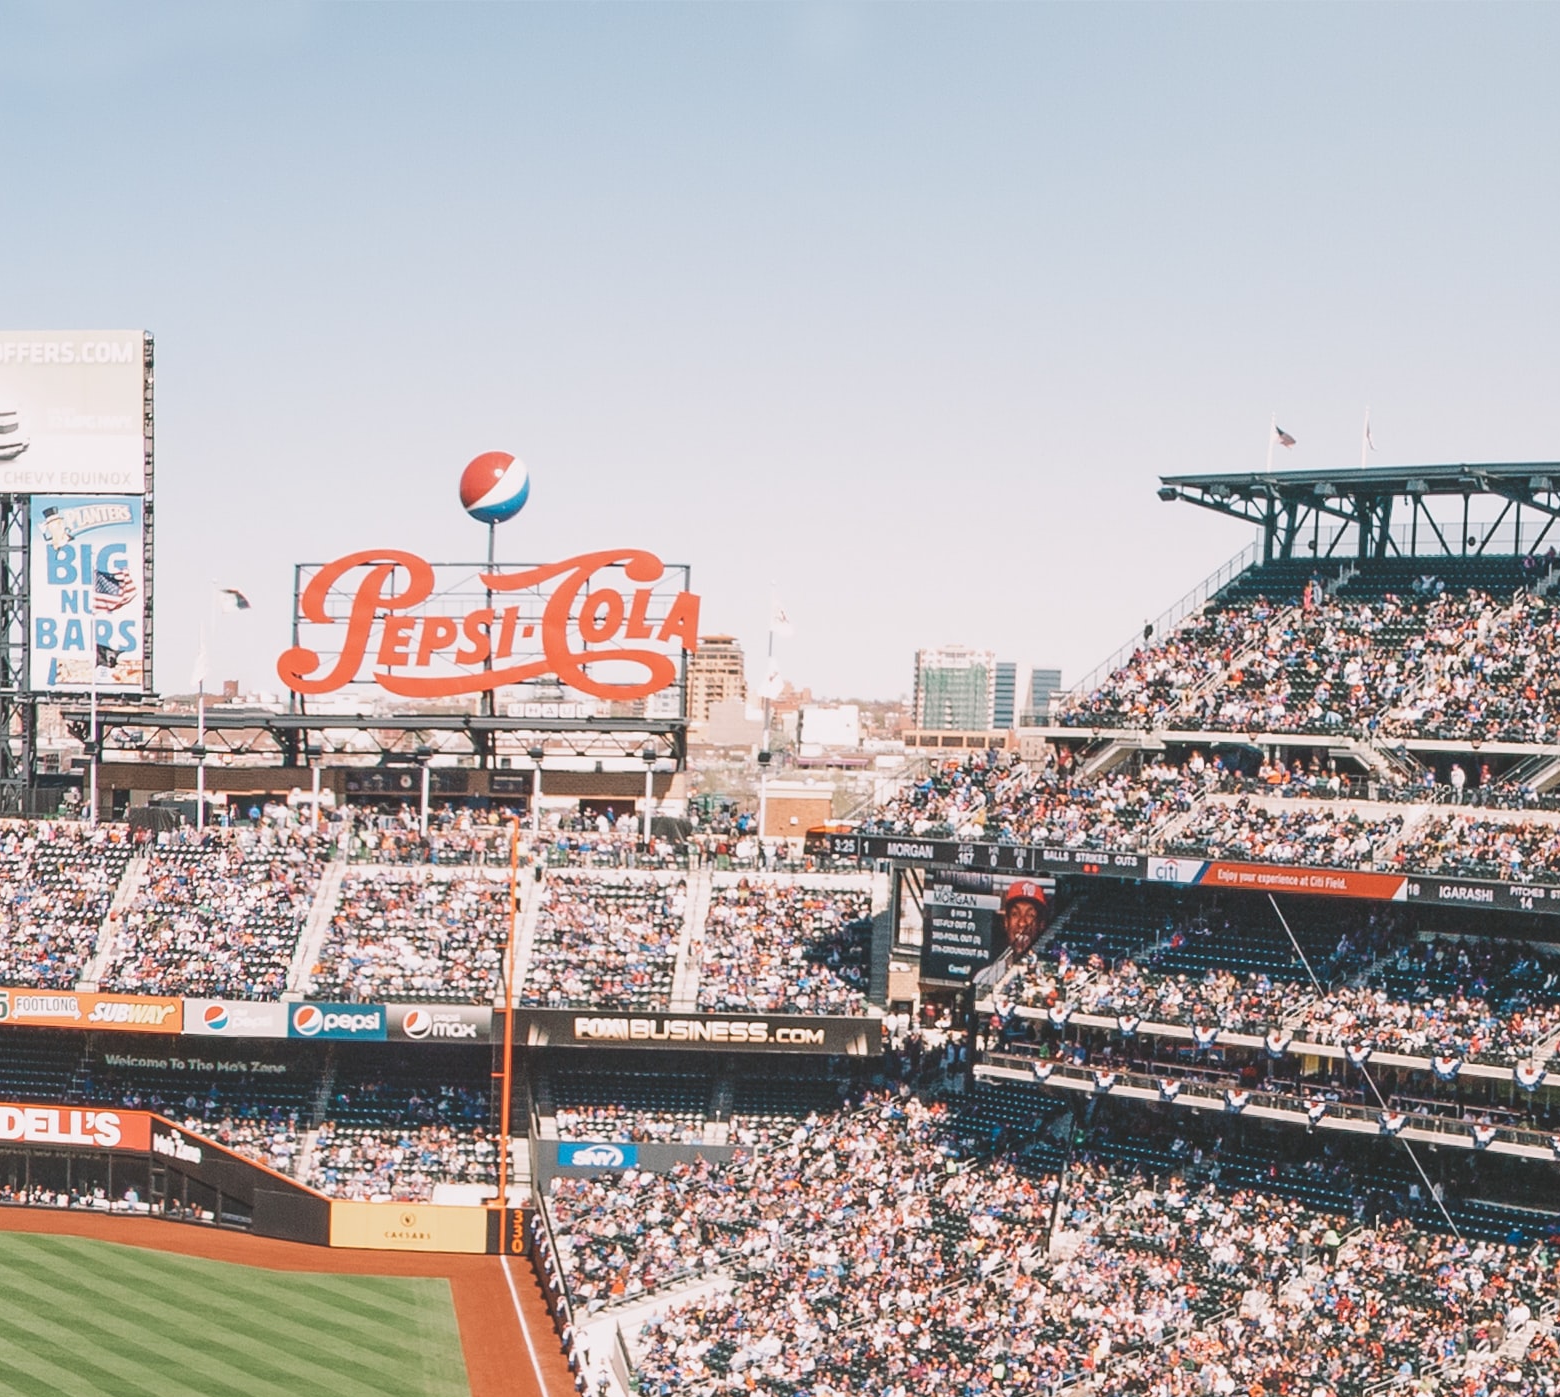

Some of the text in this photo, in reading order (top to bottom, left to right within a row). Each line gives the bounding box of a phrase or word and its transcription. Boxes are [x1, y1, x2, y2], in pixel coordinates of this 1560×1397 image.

[4, 472, 132, 486] CHEVY EQUINOX
[66, 506, 132, 530] PLANTERS
[15, 997, 78, 1013] FOOTLONG
[88, 1002, 177, 1025] SUBWAY
[323, 1012, 380, 1032] pepsi
[433, 1022, 477, 1038] max
[105, 1054, 167, 1068] Welcome
[170, 1059, 185, 1070] To
[188, 1060, 214, 1071] The
[217, 1061, 247, 1073] Mo's
[384, 1230, 431, 1241] CAESARS
[512, 1210, 523, 1253] 330
